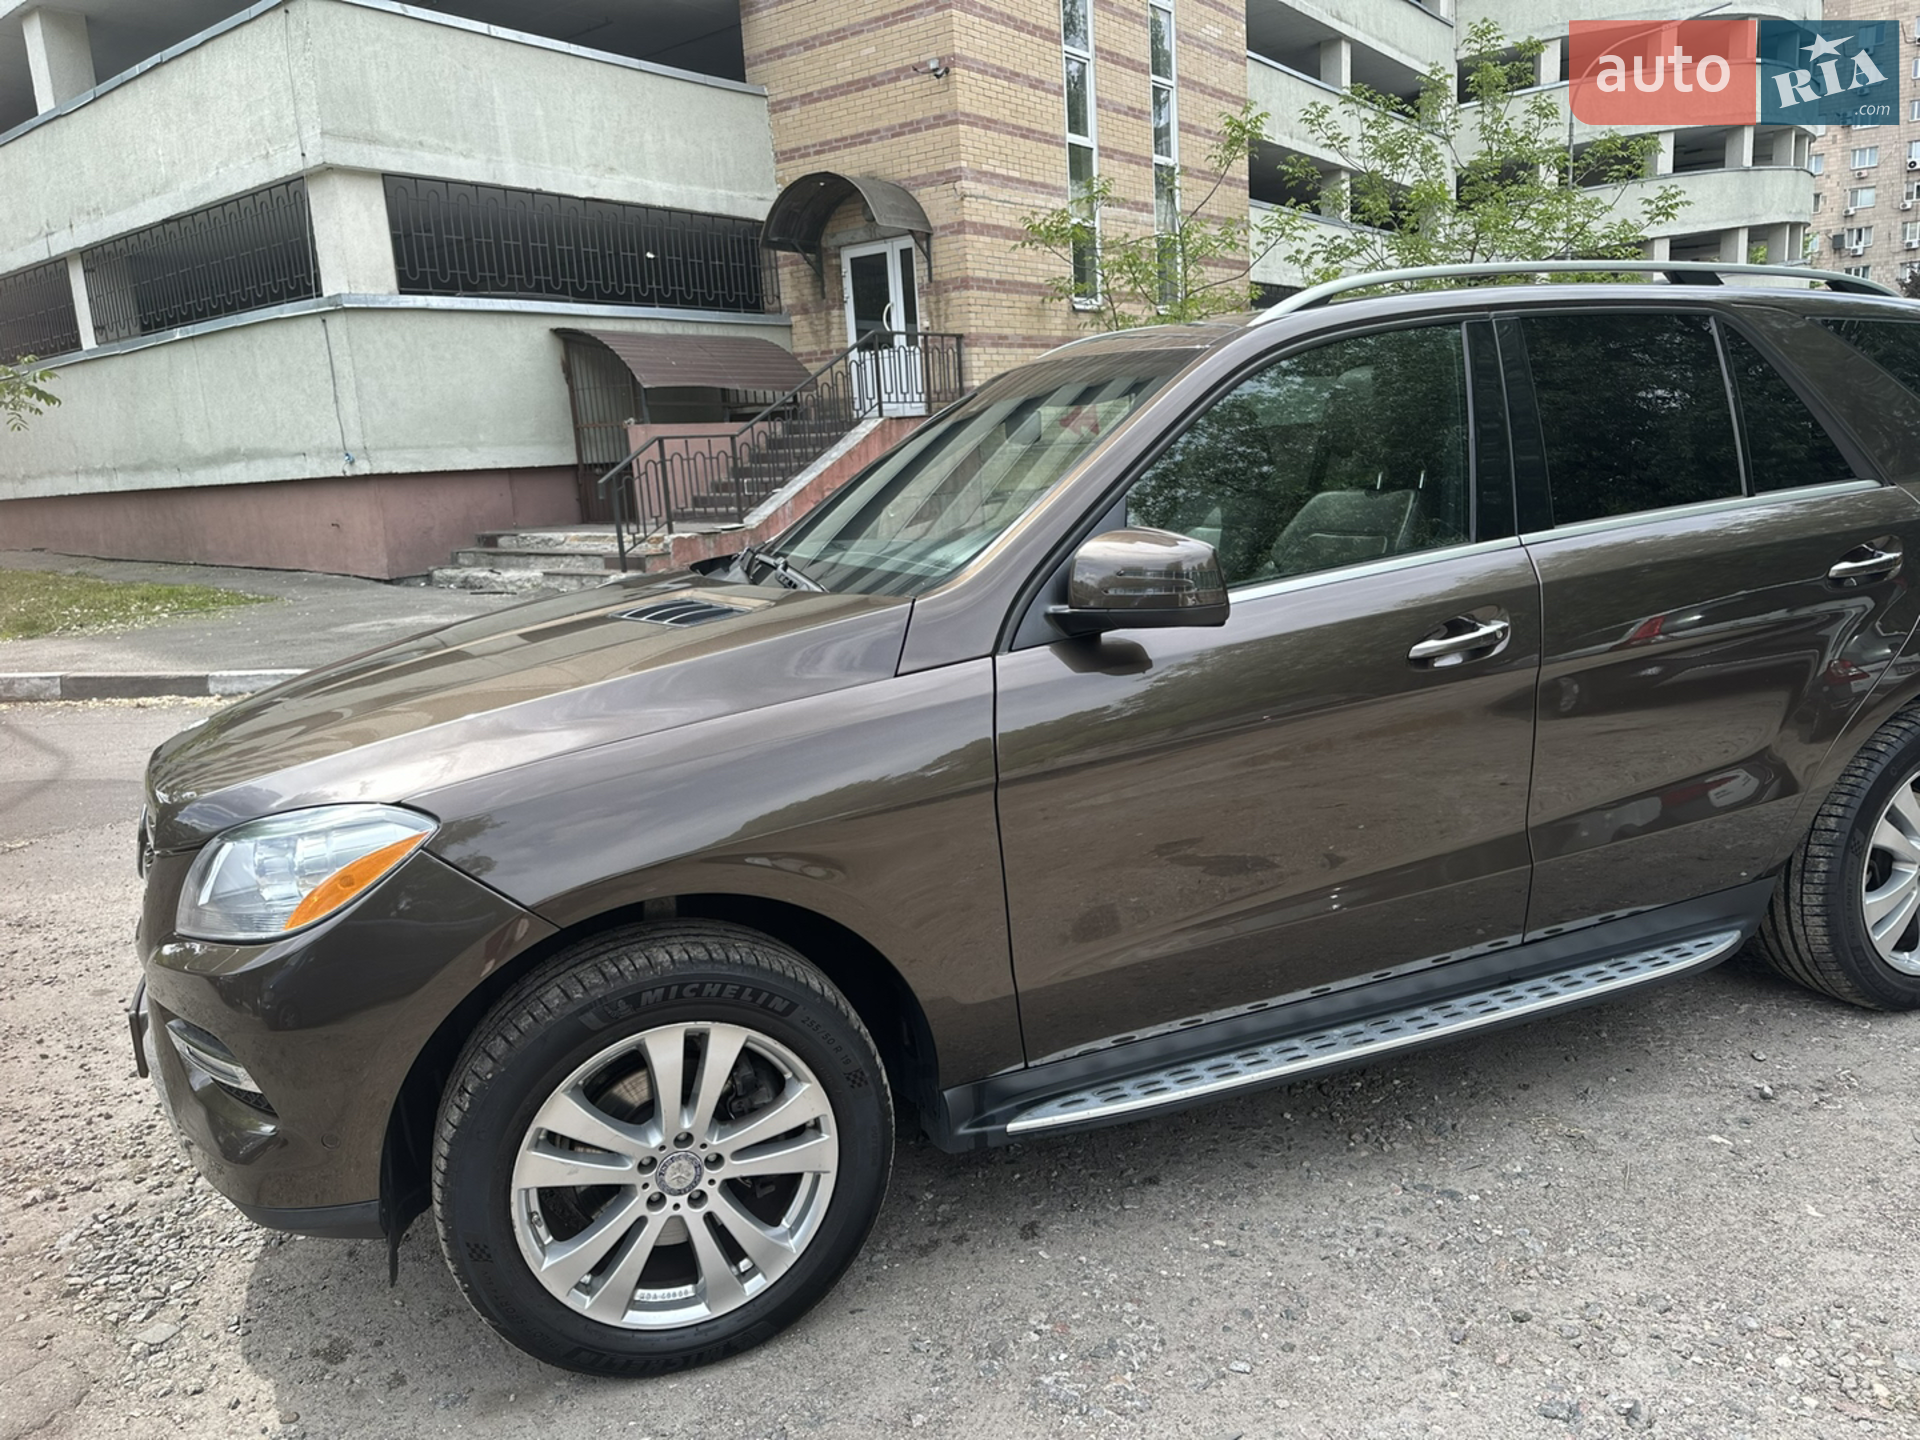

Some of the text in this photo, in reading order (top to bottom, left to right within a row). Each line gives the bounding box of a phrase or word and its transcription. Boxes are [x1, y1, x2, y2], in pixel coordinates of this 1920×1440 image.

[640, 983, 790, 1013] MICHELIN
[801, 1015, 852, 1066] 255/50 R 19
